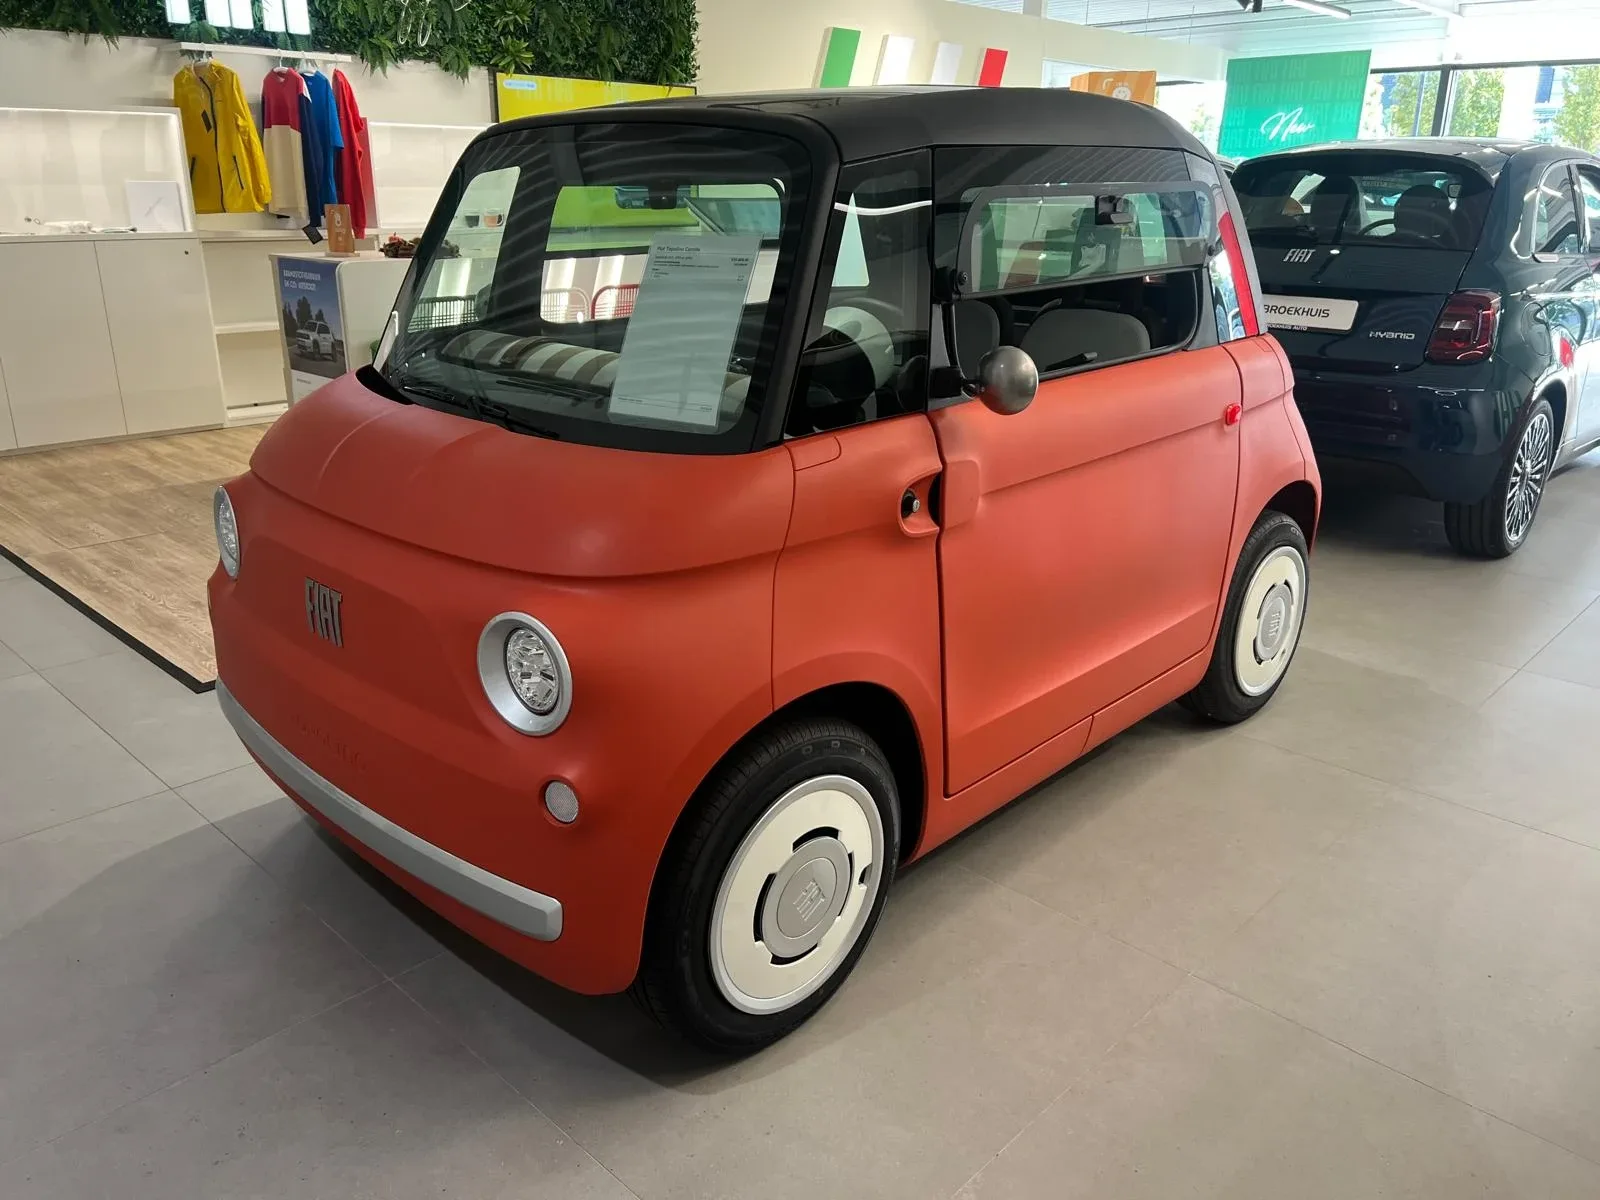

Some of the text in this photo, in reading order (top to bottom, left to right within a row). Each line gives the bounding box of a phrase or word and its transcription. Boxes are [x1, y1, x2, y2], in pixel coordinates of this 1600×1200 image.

[1260, 107, 1315, 142] New
[1283, 248, 1316, 263] FIAT
[1369, 331, 1416, 341] HYBRID
[305, 576, 344, 649] FIAT
